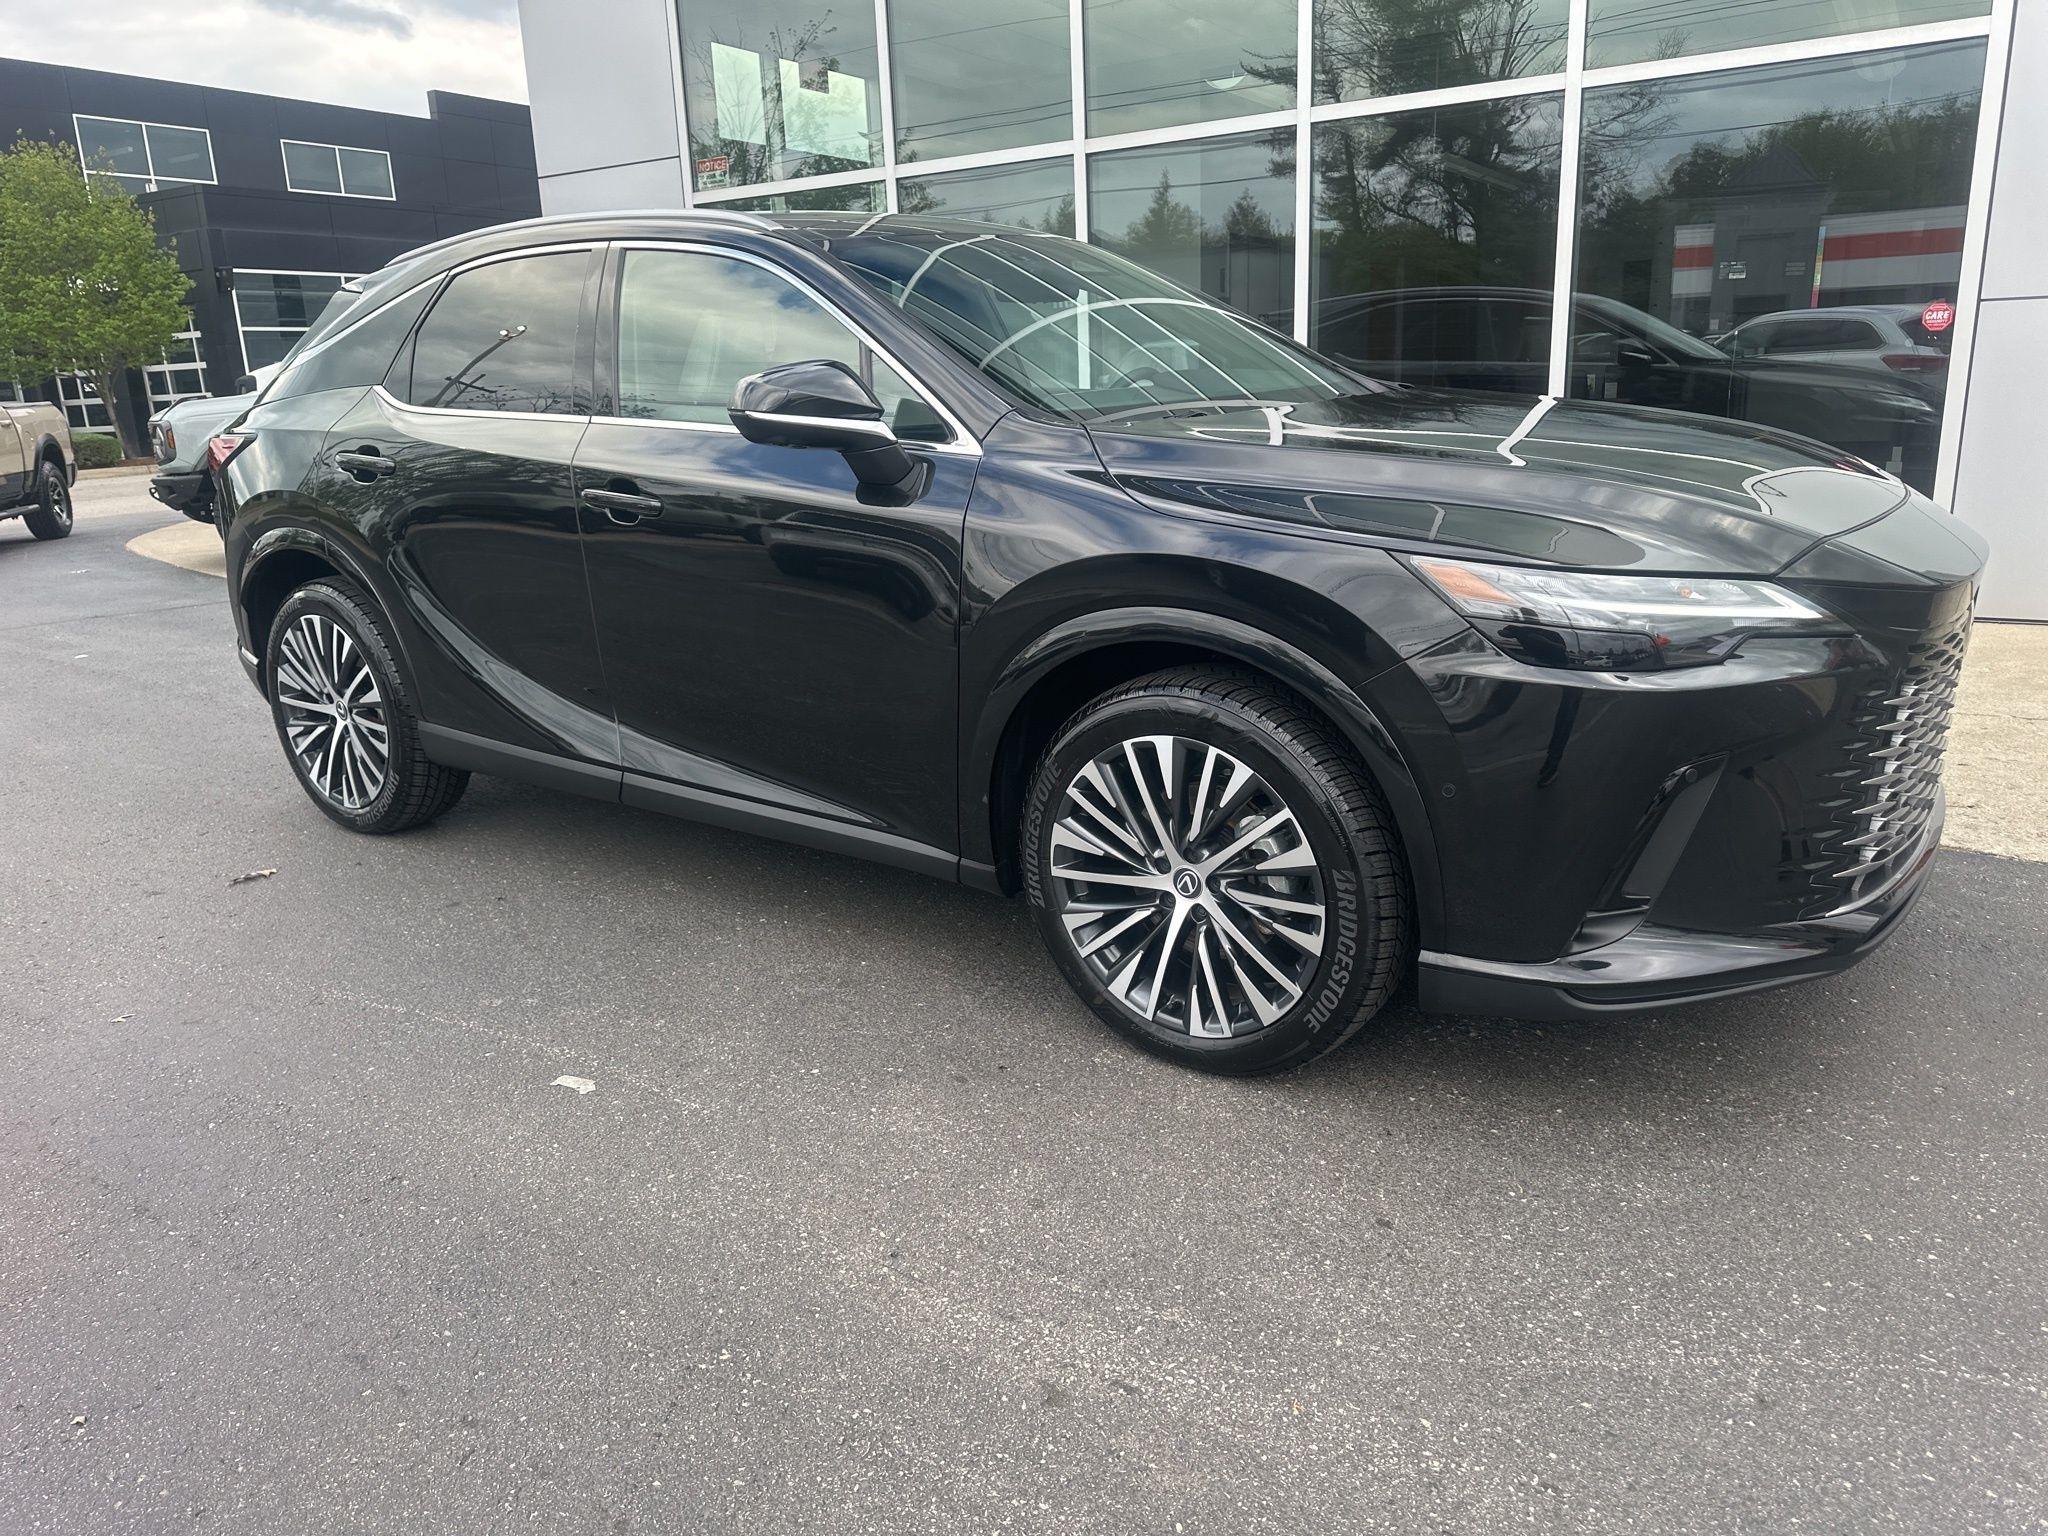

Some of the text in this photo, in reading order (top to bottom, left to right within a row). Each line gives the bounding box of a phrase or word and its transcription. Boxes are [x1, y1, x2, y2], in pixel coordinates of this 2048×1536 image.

[698, 159, 726, 173] NOTICE
[1925, 310, 1951, 320] CARE
[1023, 761, 1063, 909] BRIDGESTONE
[1303, 869, 1360, 1034] BRIDGESTONE
